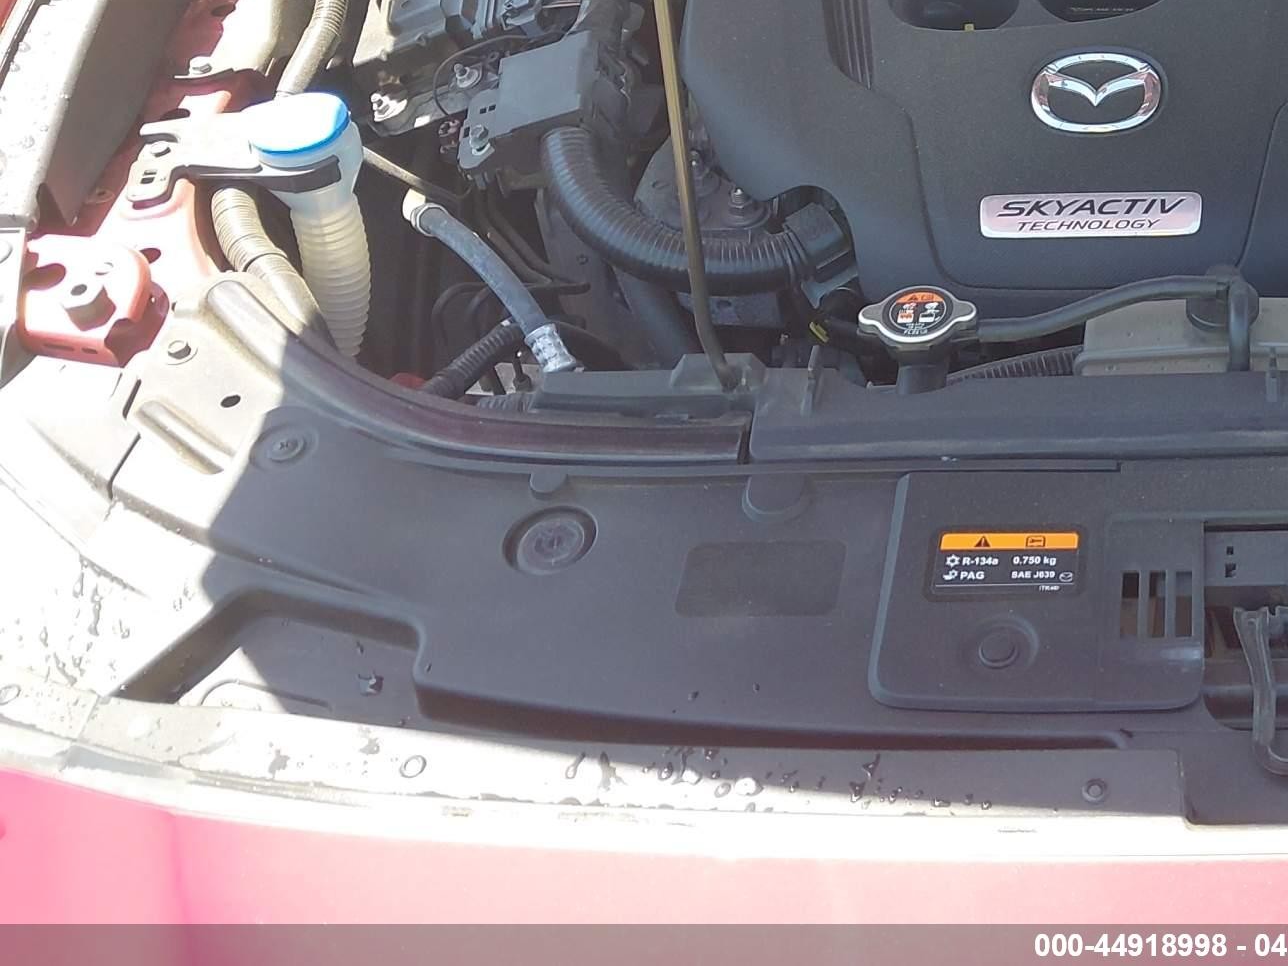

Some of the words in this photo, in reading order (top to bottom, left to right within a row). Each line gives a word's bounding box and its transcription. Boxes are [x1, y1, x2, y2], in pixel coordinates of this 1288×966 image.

[996, 198, 1187, 217] SKYACTIV
[1017, 218, 1160, 232] TECHNOLOGY
[961, 556, 999, 566] R-134a
[1012, 556, 1041, 565] 0.750
[1043, 556, 1057, 566] kg
[959, 570, 985, 580] PAG
[1011, 570, 1032, 579] SAE
